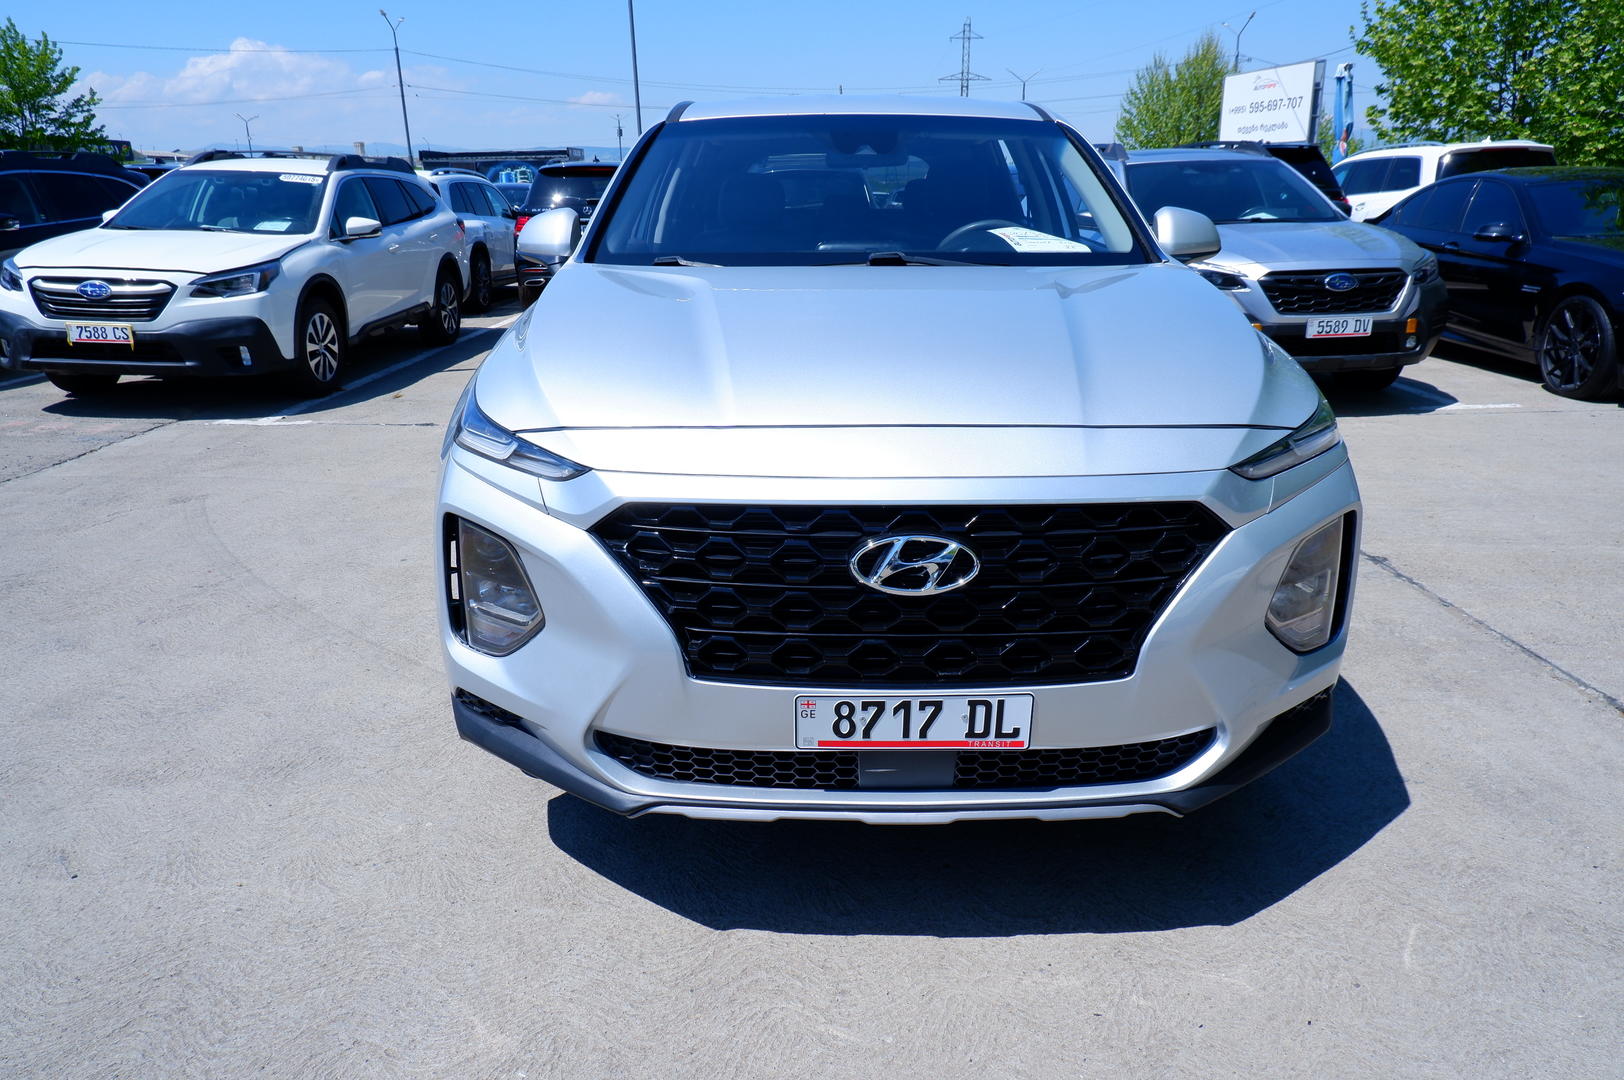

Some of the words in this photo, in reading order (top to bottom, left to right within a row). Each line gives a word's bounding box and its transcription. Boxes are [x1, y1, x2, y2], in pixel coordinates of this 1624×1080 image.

[1249, 96, 1303, 114] 595-697-707
[76, 326, 108, 339] 7588
[112, 327, 130, 340] CS
[1317, 319, 1348, 334] 5589
[1353, 319, 1370, 333] DV
[800, 709, 816, 719] GE
[832, 699, 943, 739] 8717
[964, 698, 1021, 739] DL
[967, 740, 1012, 748] TRANSIT
